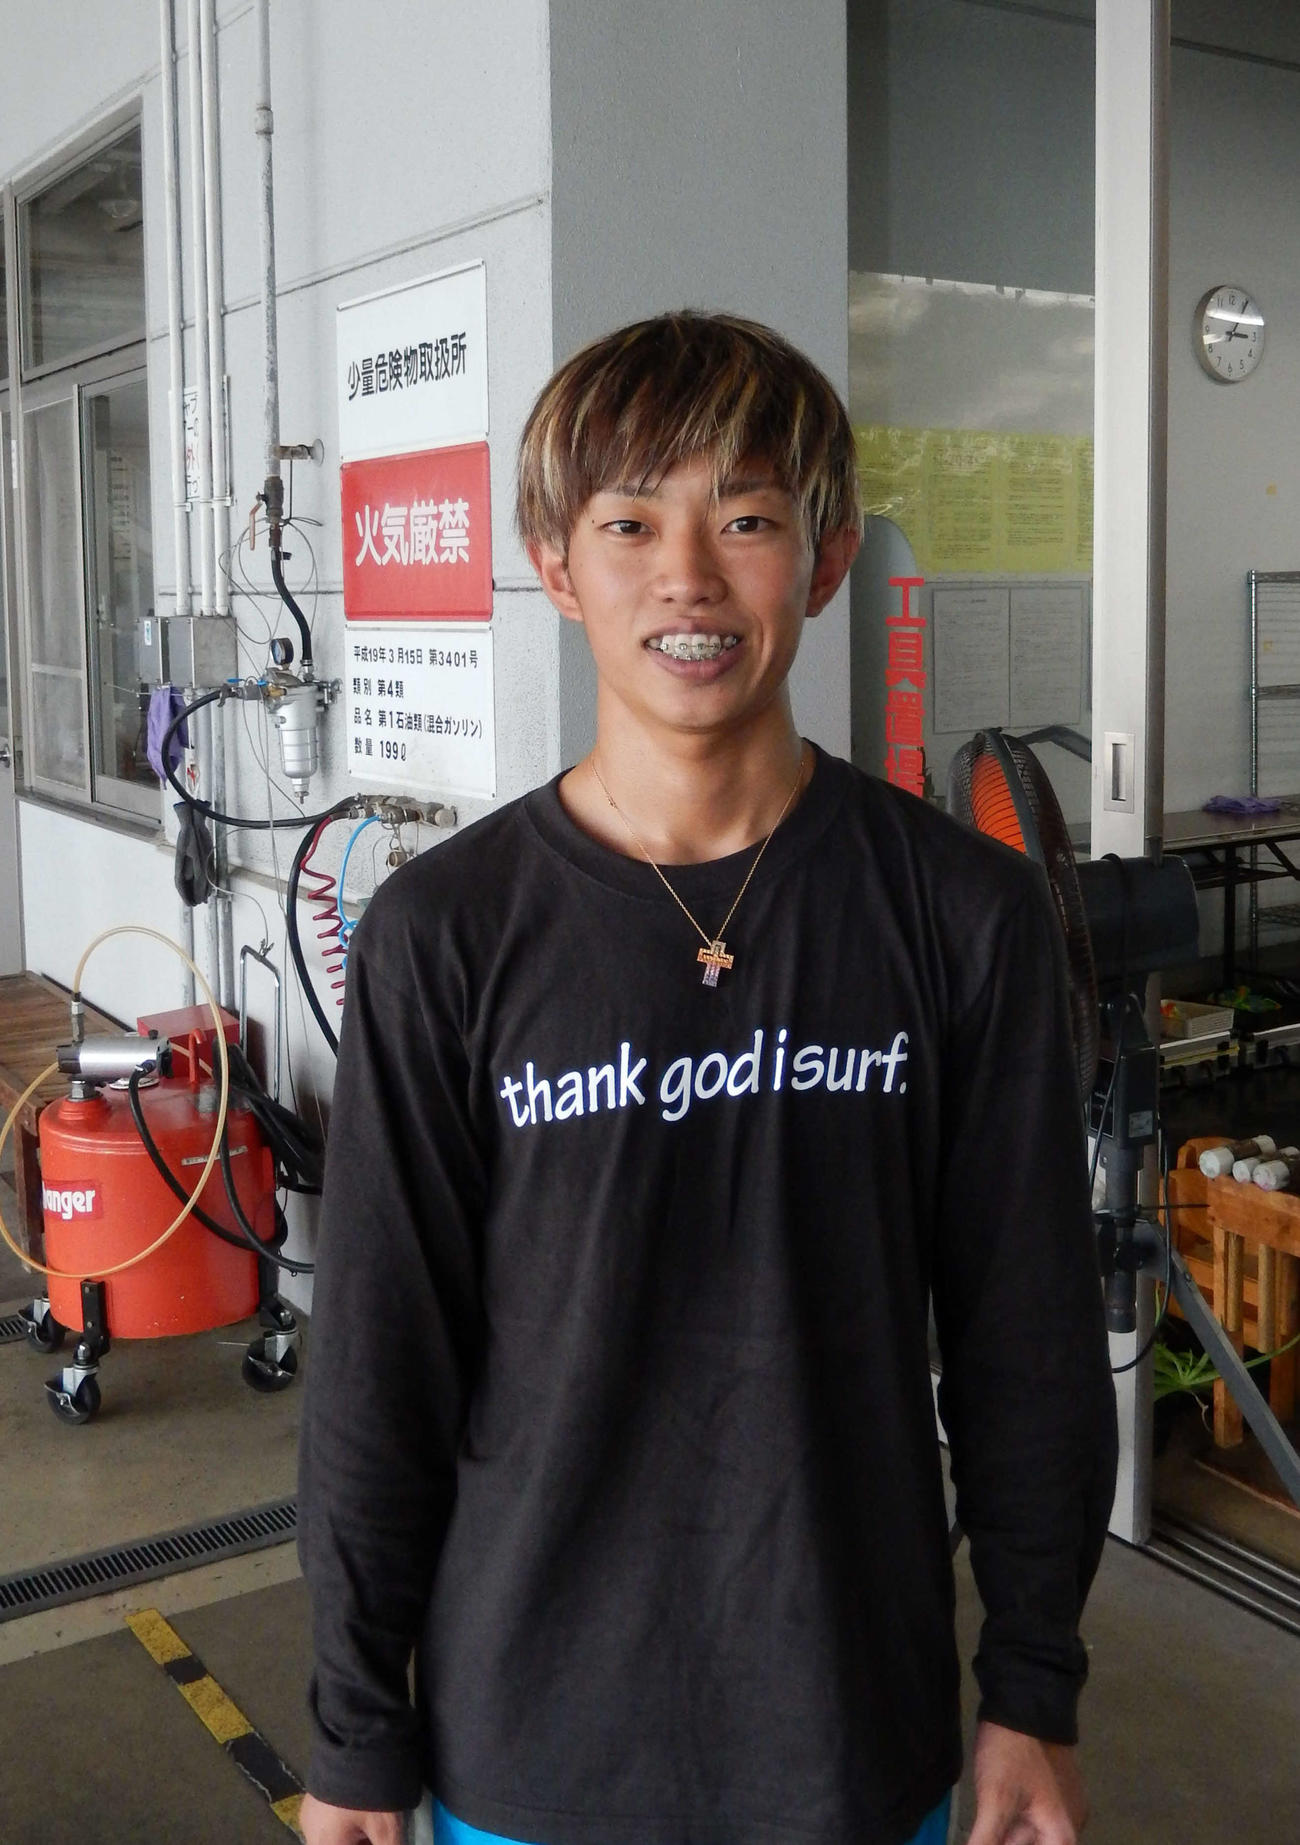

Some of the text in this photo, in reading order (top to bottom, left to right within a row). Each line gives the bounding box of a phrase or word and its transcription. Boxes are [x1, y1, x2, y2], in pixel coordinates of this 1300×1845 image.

[347, 331, 467, 401] 少量危険物取扱所
[355, 497, 470, 567] 火気厳禁
[428, 648, 479, 669] 第3401号
[377, 679, 405, 699] 第4類
[378, 708, 483, 740] 第1石油類(混合ガソリン)
[500, 1028, 909, 1128] thank god i surf.
